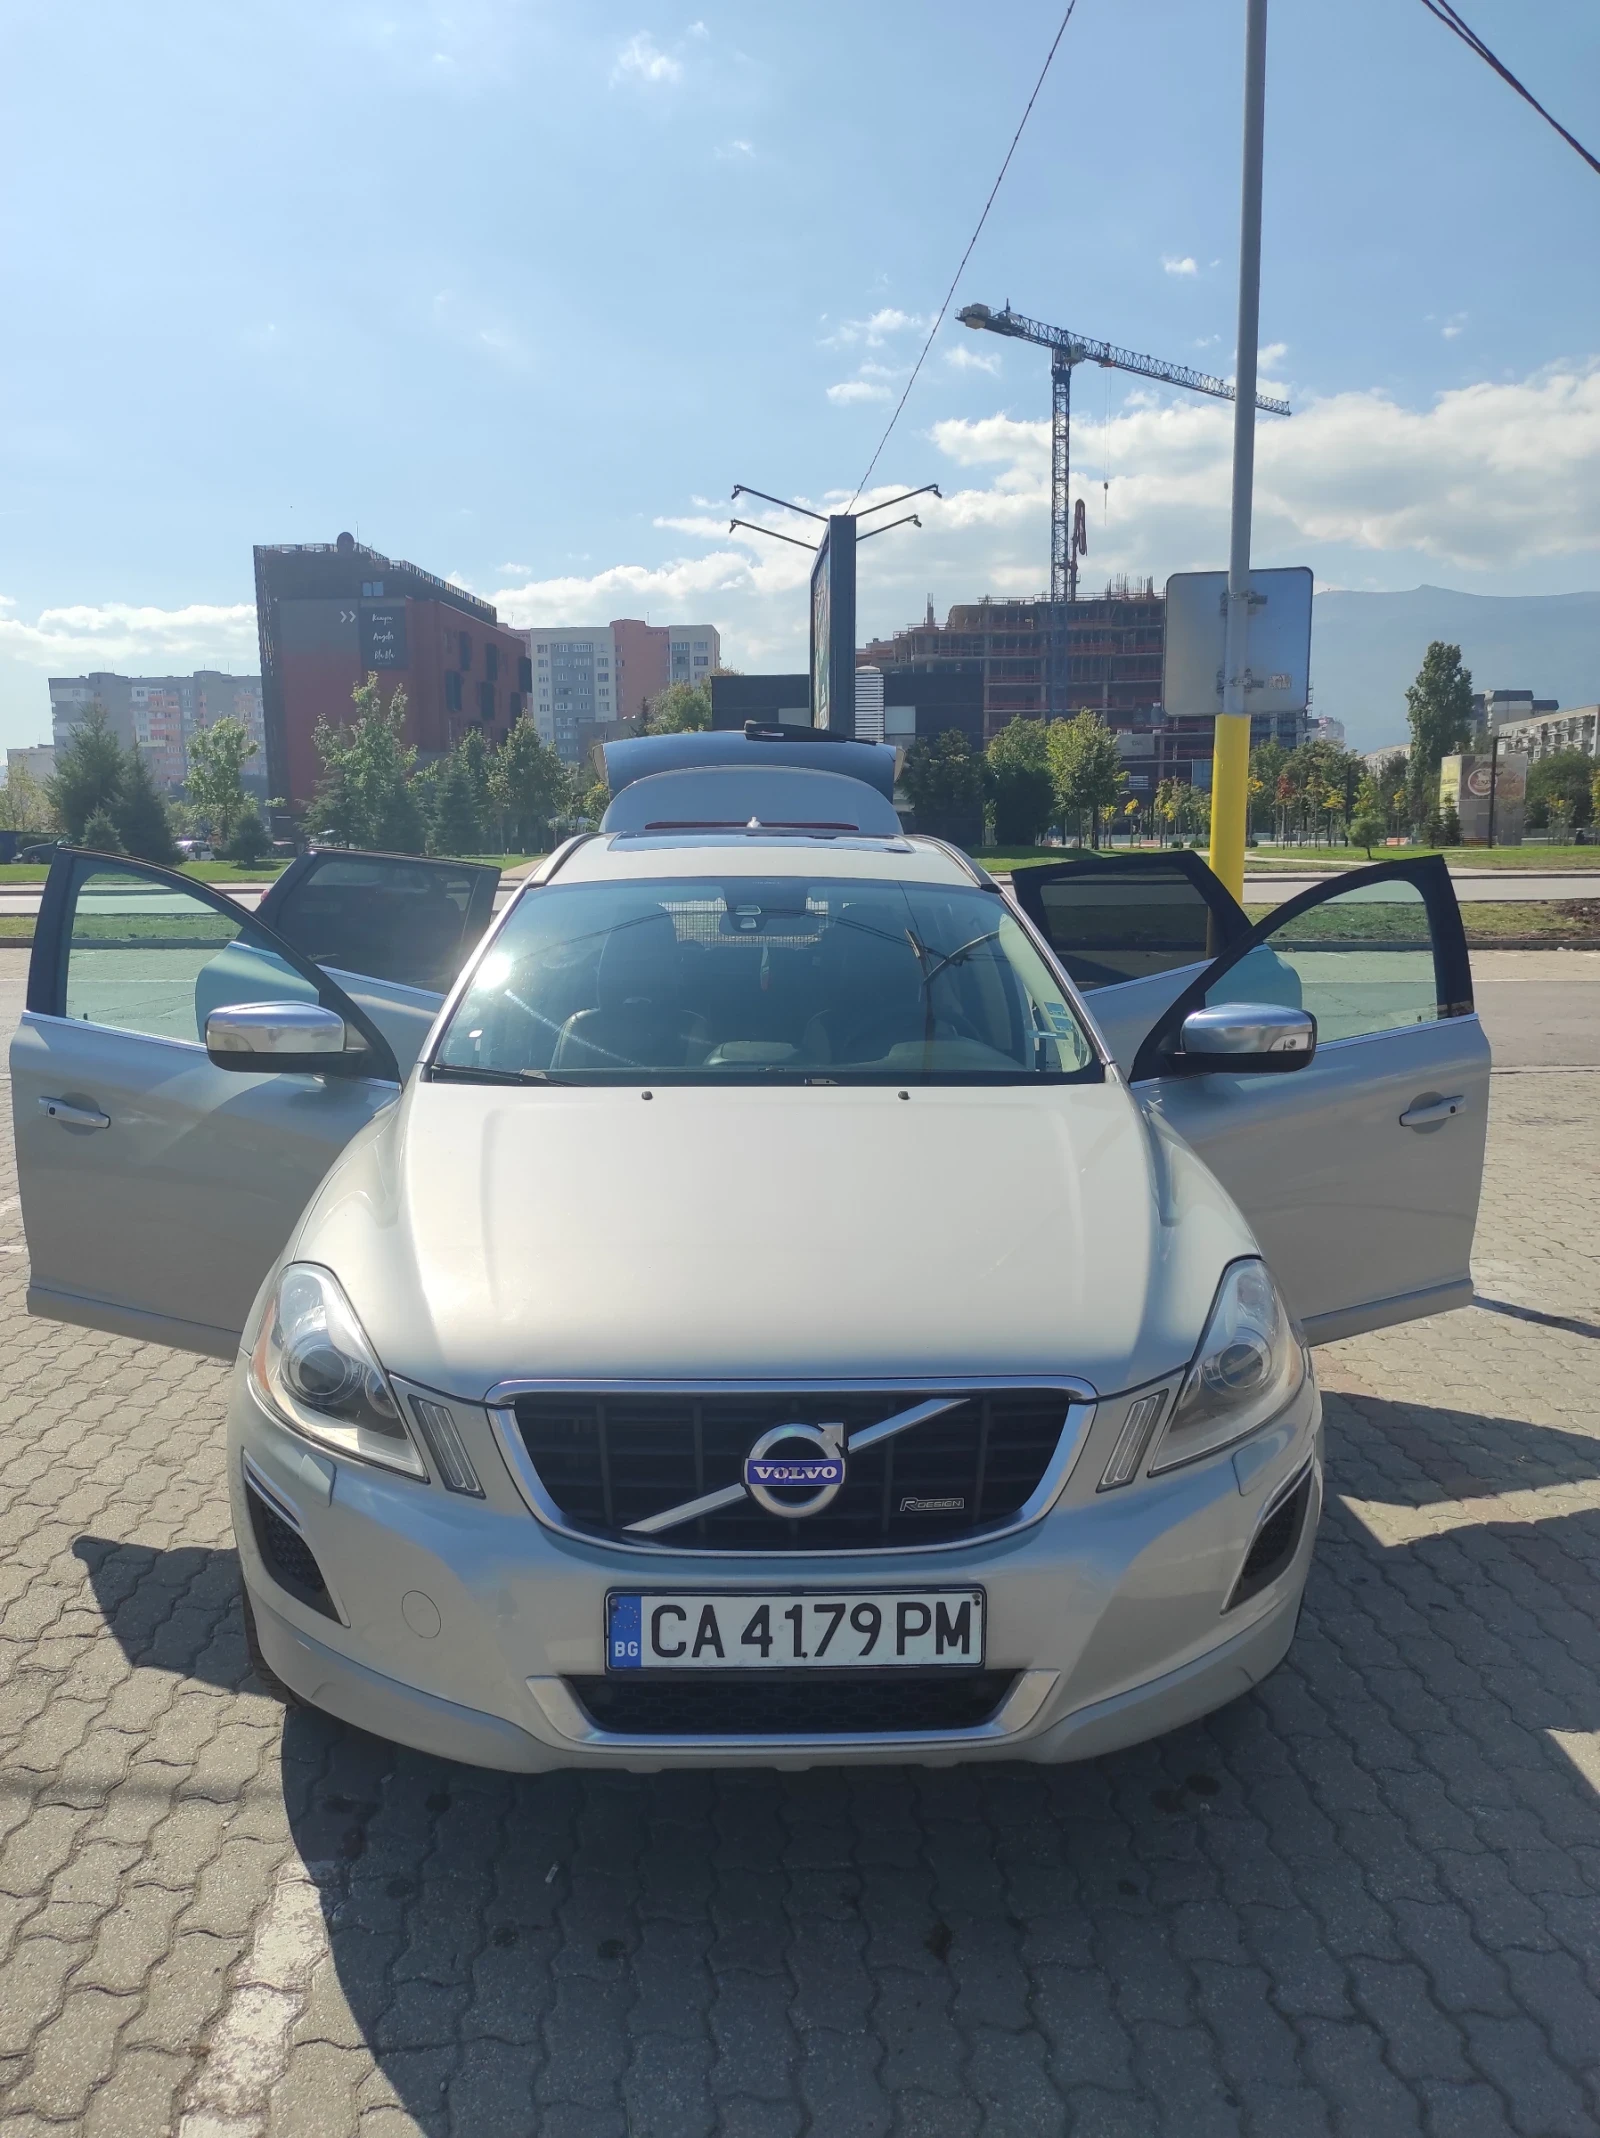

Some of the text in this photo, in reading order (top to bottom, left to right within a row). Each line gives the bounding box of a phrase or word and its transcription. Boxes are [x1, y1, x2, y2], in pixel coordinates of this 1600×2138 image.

[753, 1466, 838, 1479] VOLVO
[651, 1601, 971, 1658] CA 4179 PM
[614, 1641, 639, 1657] BG
